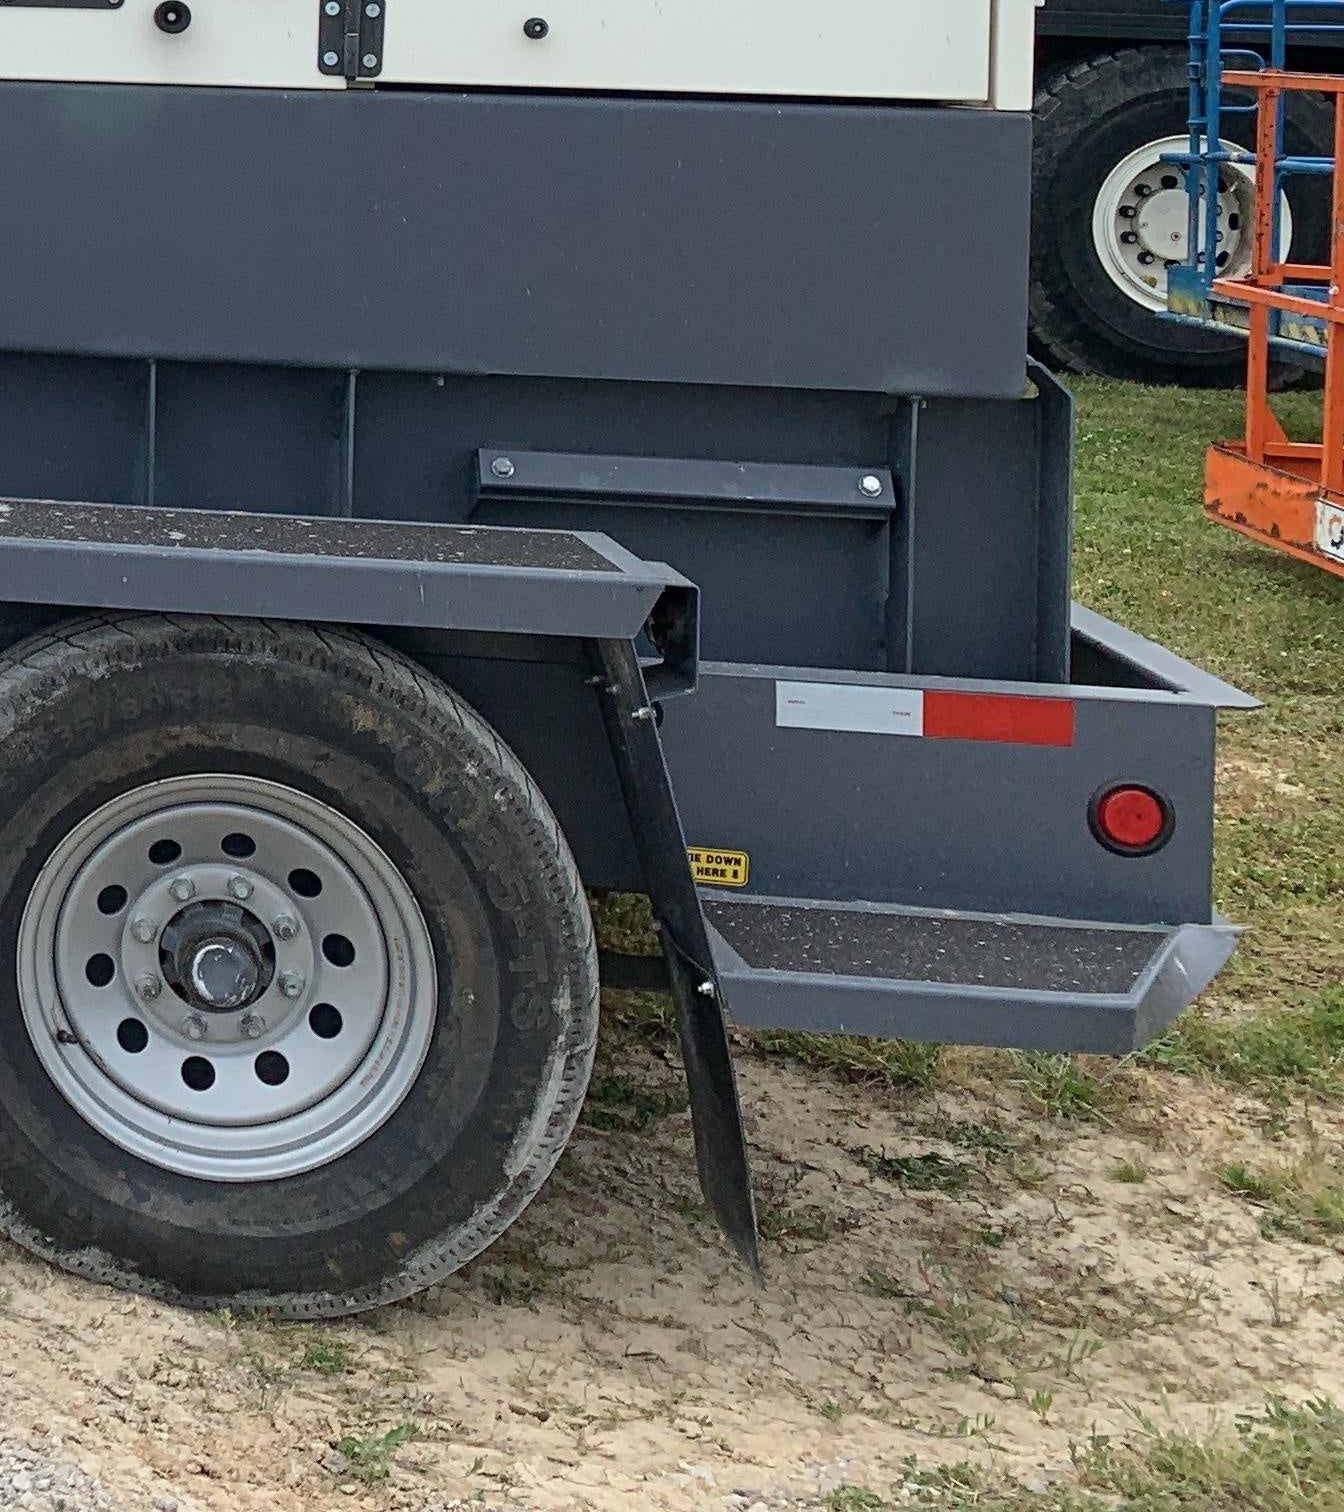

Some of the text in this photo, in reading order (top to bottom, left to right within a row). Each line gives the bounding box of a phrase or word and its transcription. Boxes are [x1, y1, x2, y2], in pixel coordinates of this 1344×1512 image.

[687, 853, 741, 866] IE DOWN
[696, 867, 728, 878] HERE
